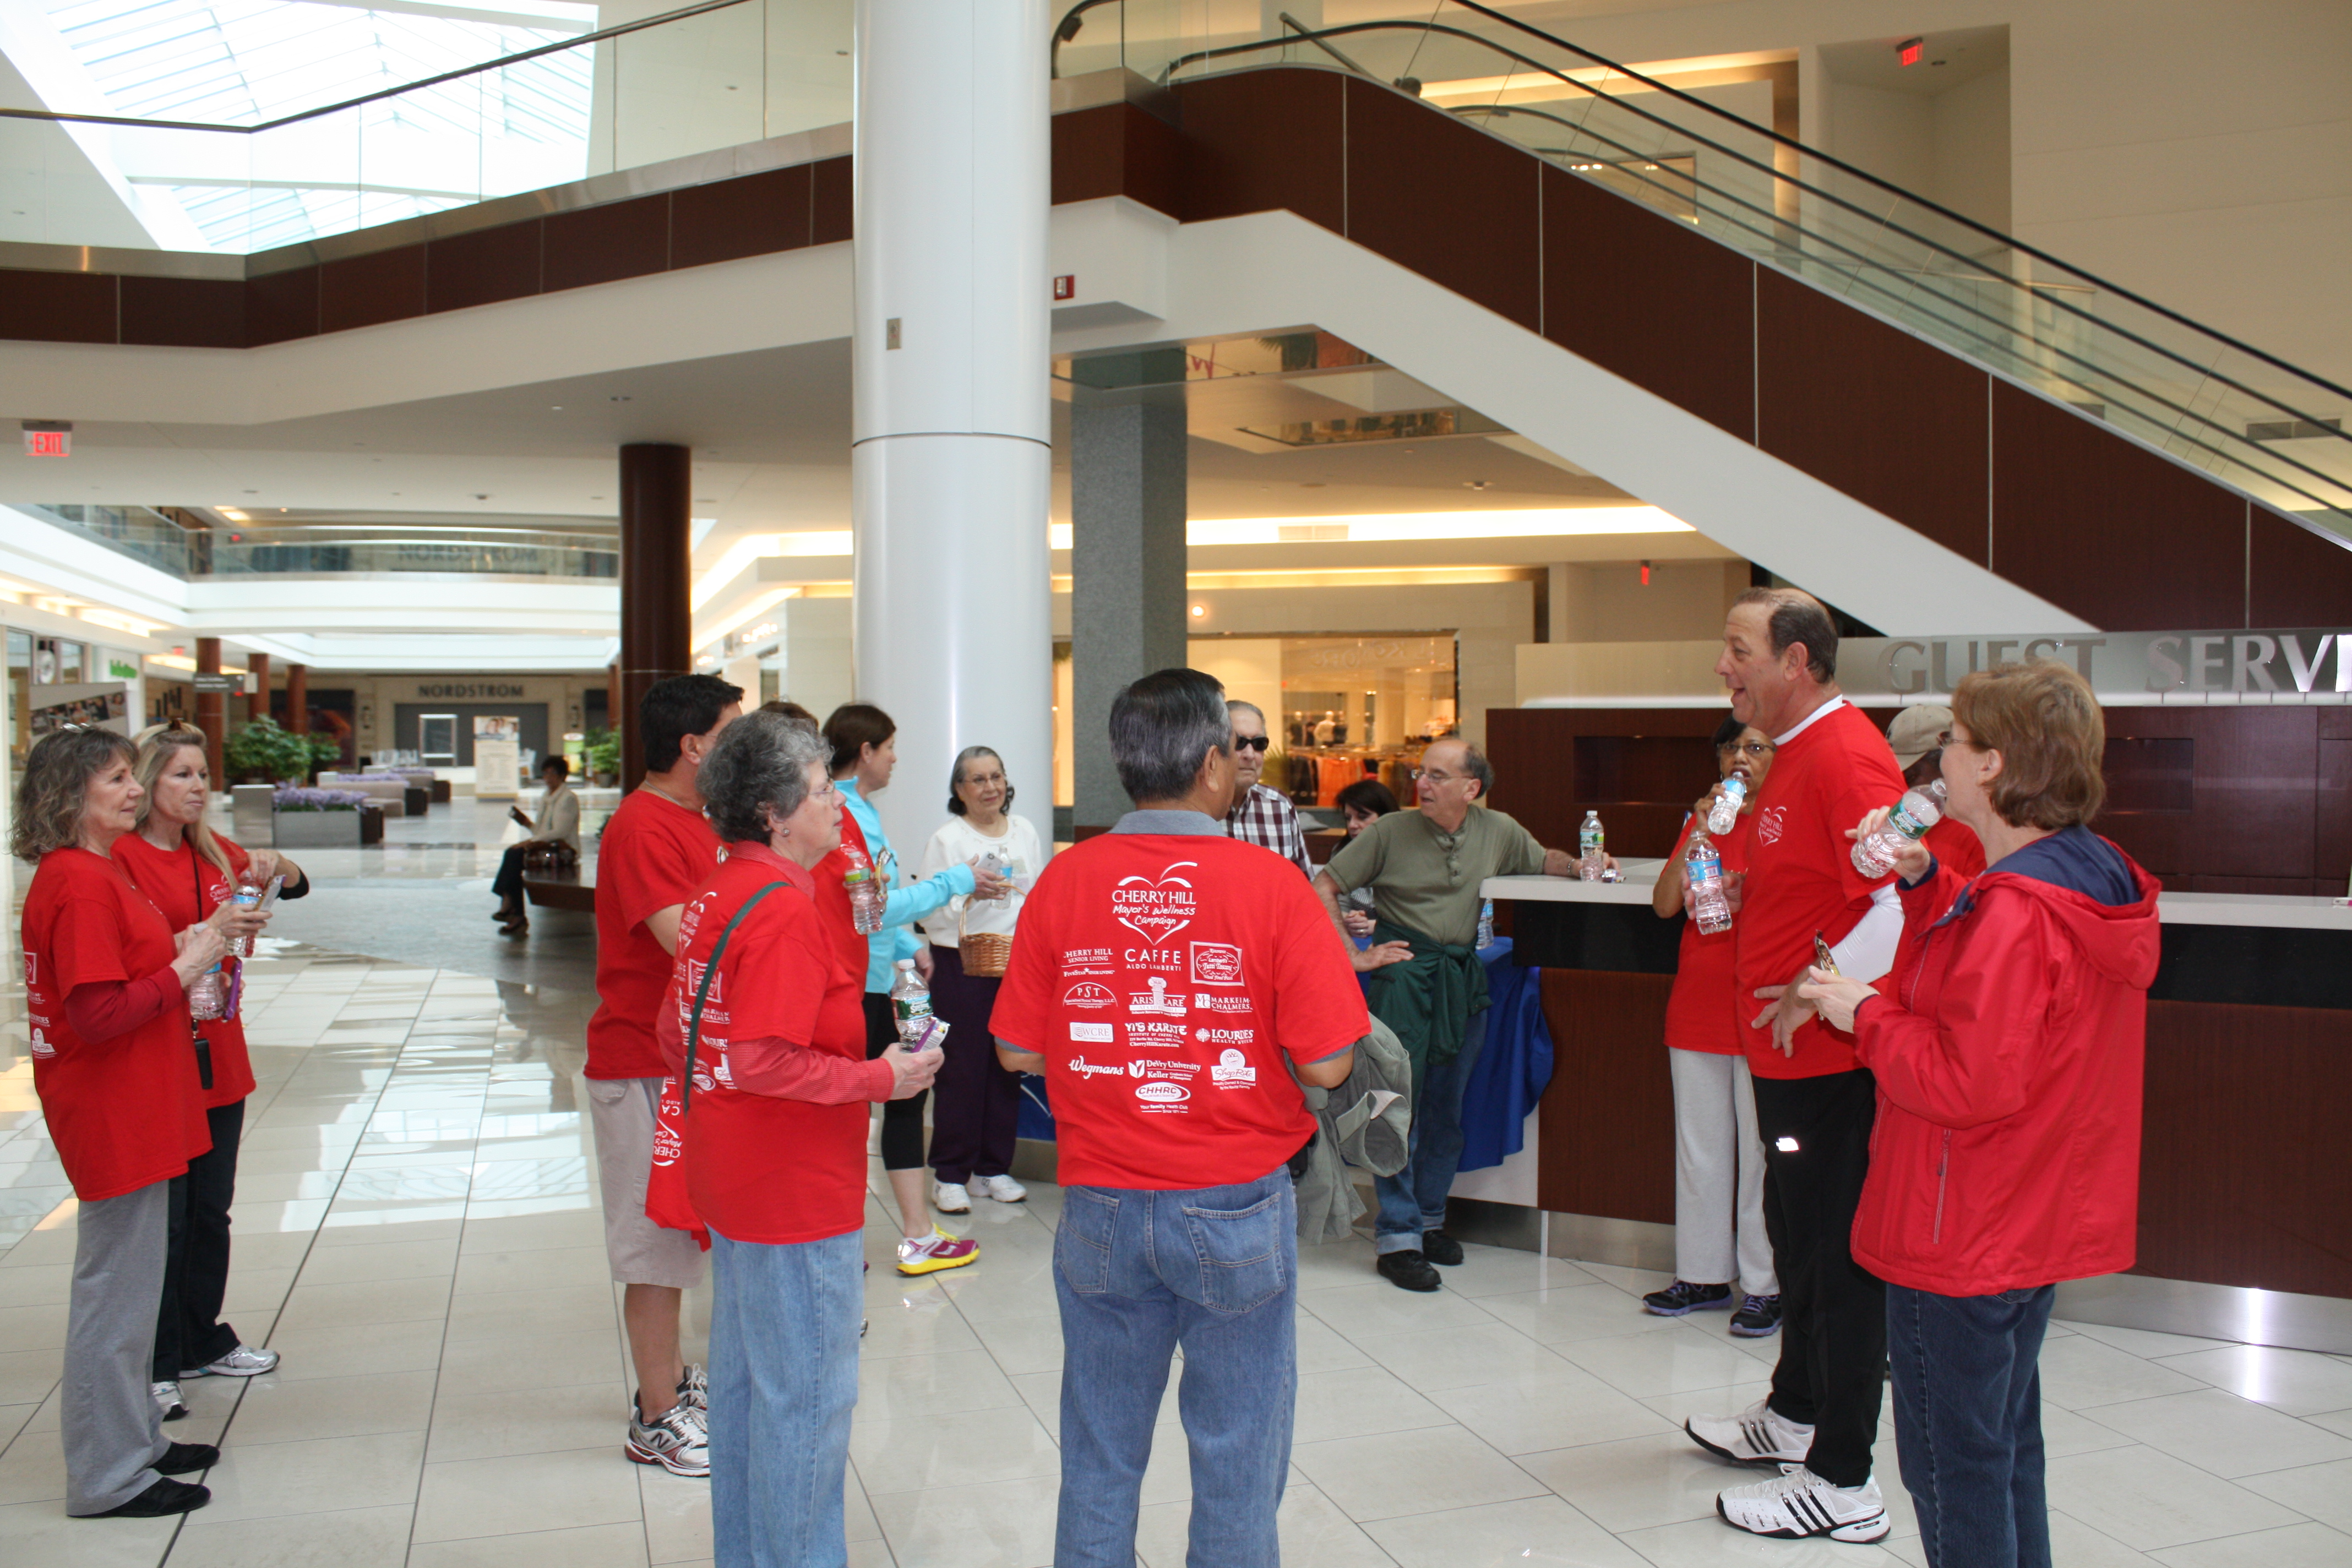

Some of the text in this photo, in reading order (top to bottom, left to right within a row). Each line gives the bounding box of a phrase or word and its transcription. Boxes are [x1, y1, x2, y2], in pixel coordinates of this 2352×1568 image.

[33, 432, 63, 453] EXIT
[418, 684, 523, 698] NORDSTROM
[1112, 890, 1197, 905] CHERRY HILL
[1113, 904, 1196, 917] Mayor's Wellness
[1134, 915, 1176, 929] Campaign
[1124, 948, 1181, 964] CAFFE
[1083, 1028, 1110, 1037] WCRE
[1125, 1022, 1188, 1035] YI'S KARATE
[1211, 1028, 1254, 1040] LOURDES
[1068, 1055, 1124, 1080] Wegmans
[1146, 1060, 1201, 1071] DeVry University
[1215, 1068, 1253, 1079] ShopRite
